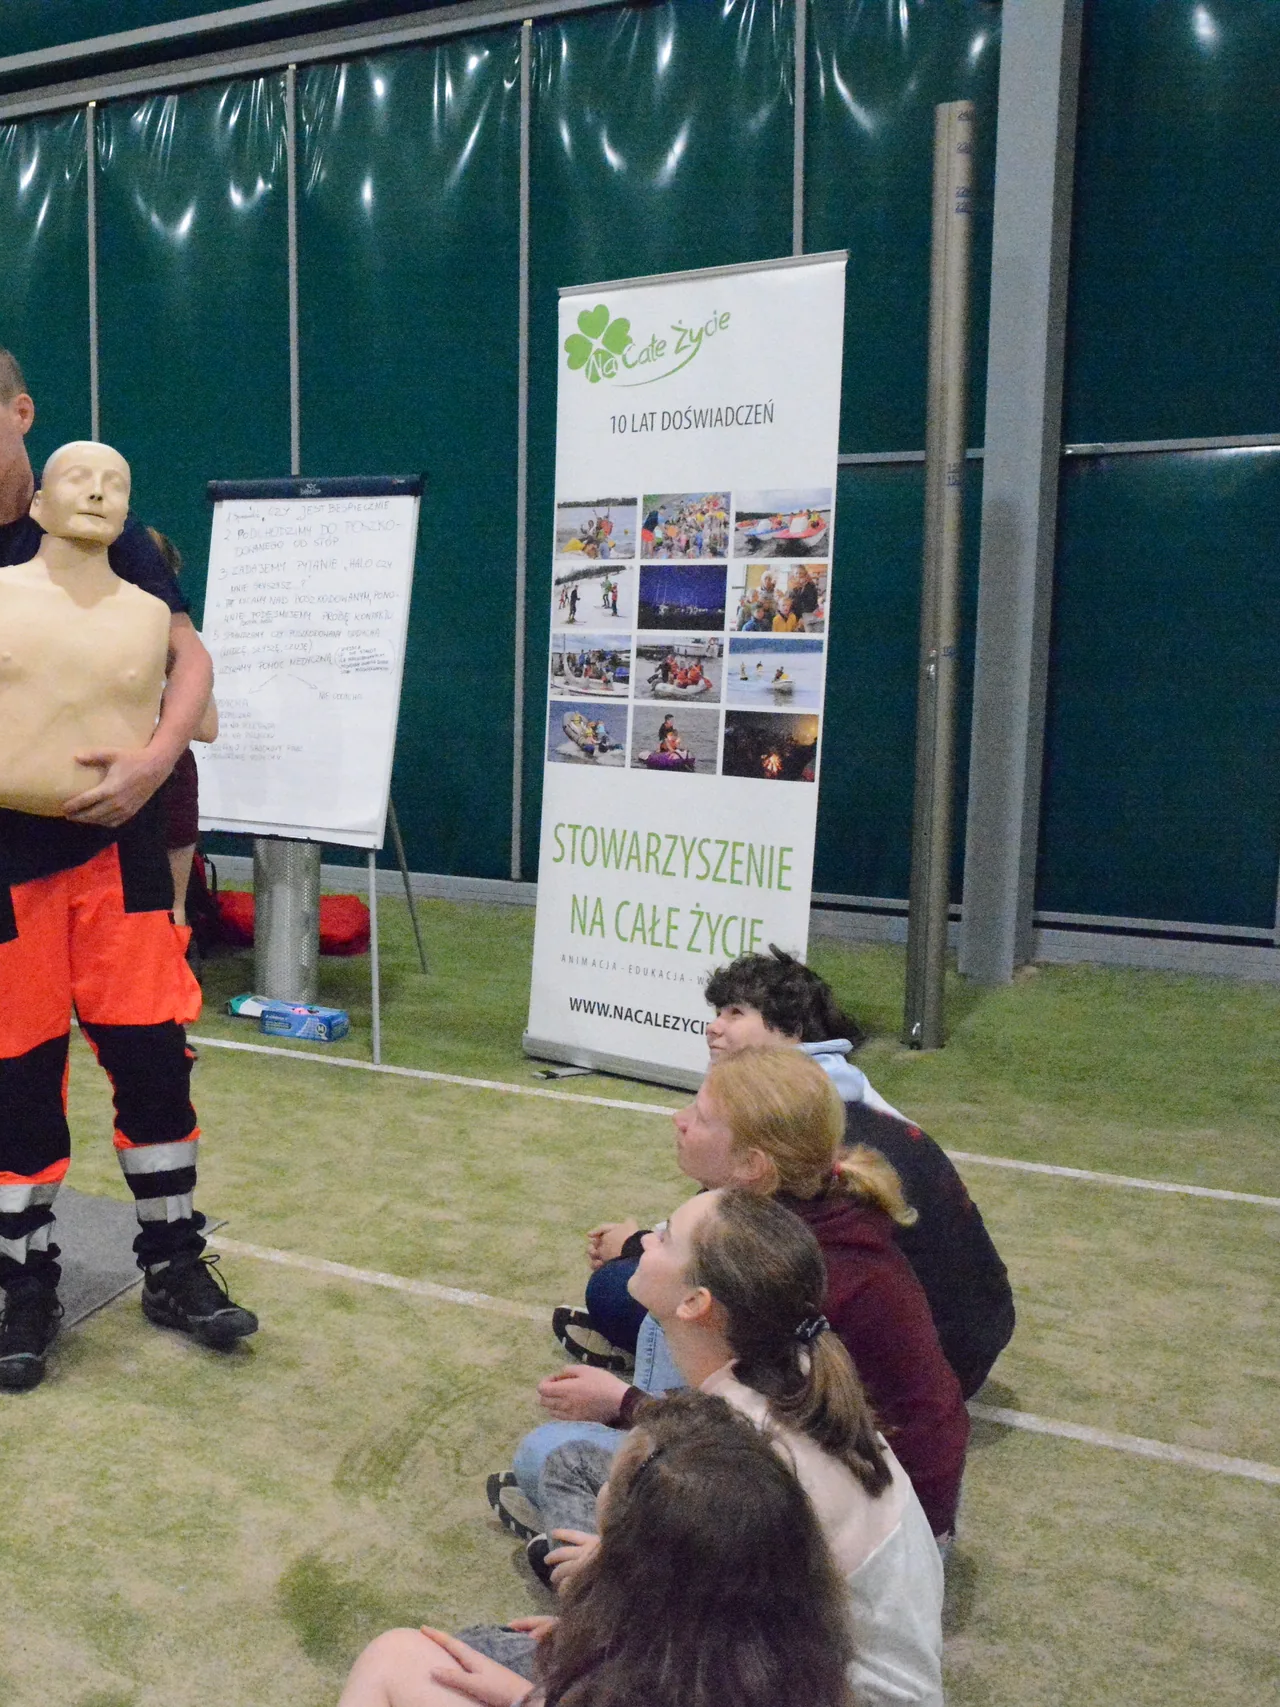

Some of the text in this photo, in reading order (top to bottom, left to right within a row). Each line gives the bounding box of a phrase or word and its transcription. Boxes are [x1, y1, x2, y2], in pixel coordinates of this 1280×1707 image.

[611, 399, 774, 434] 10 LAT DOŚWIADCZEŃ
[552, 823, 794, 891] STOWARZYSZENIE
[570, 894, 764, 959] NA CAŁE ŻYCIE
[561, 954, 617, 971] ANIMACJA
[628, 964, 685, 982] EDUKACJA
[569, 997, 709, 1036] WWW.NACALEZYCI
